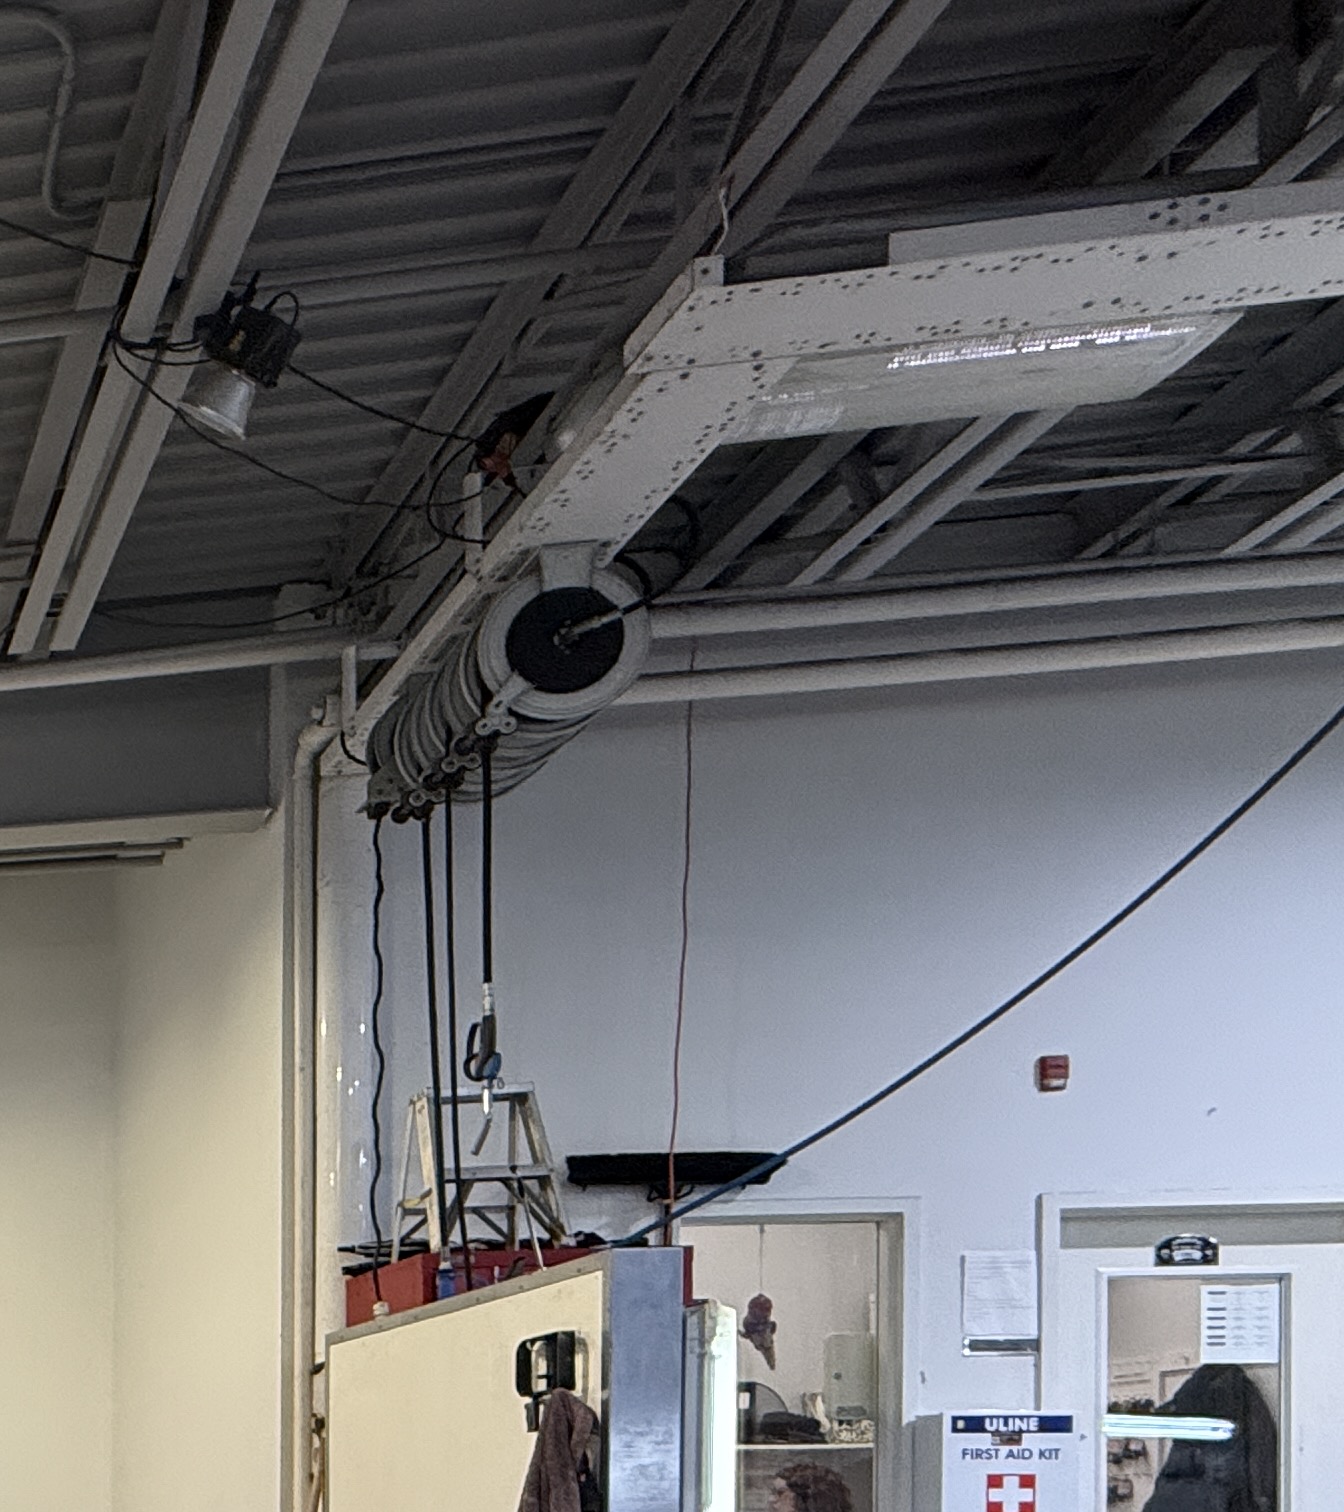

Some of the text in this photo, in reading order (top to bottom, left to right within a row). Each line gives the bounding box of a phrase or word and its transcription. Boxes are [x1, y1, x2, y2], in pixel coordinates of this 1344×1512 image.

[984, 1417, 1040, 1432] ULINE
[961, 1448, 1061, 1460] FIRST AID KIT
